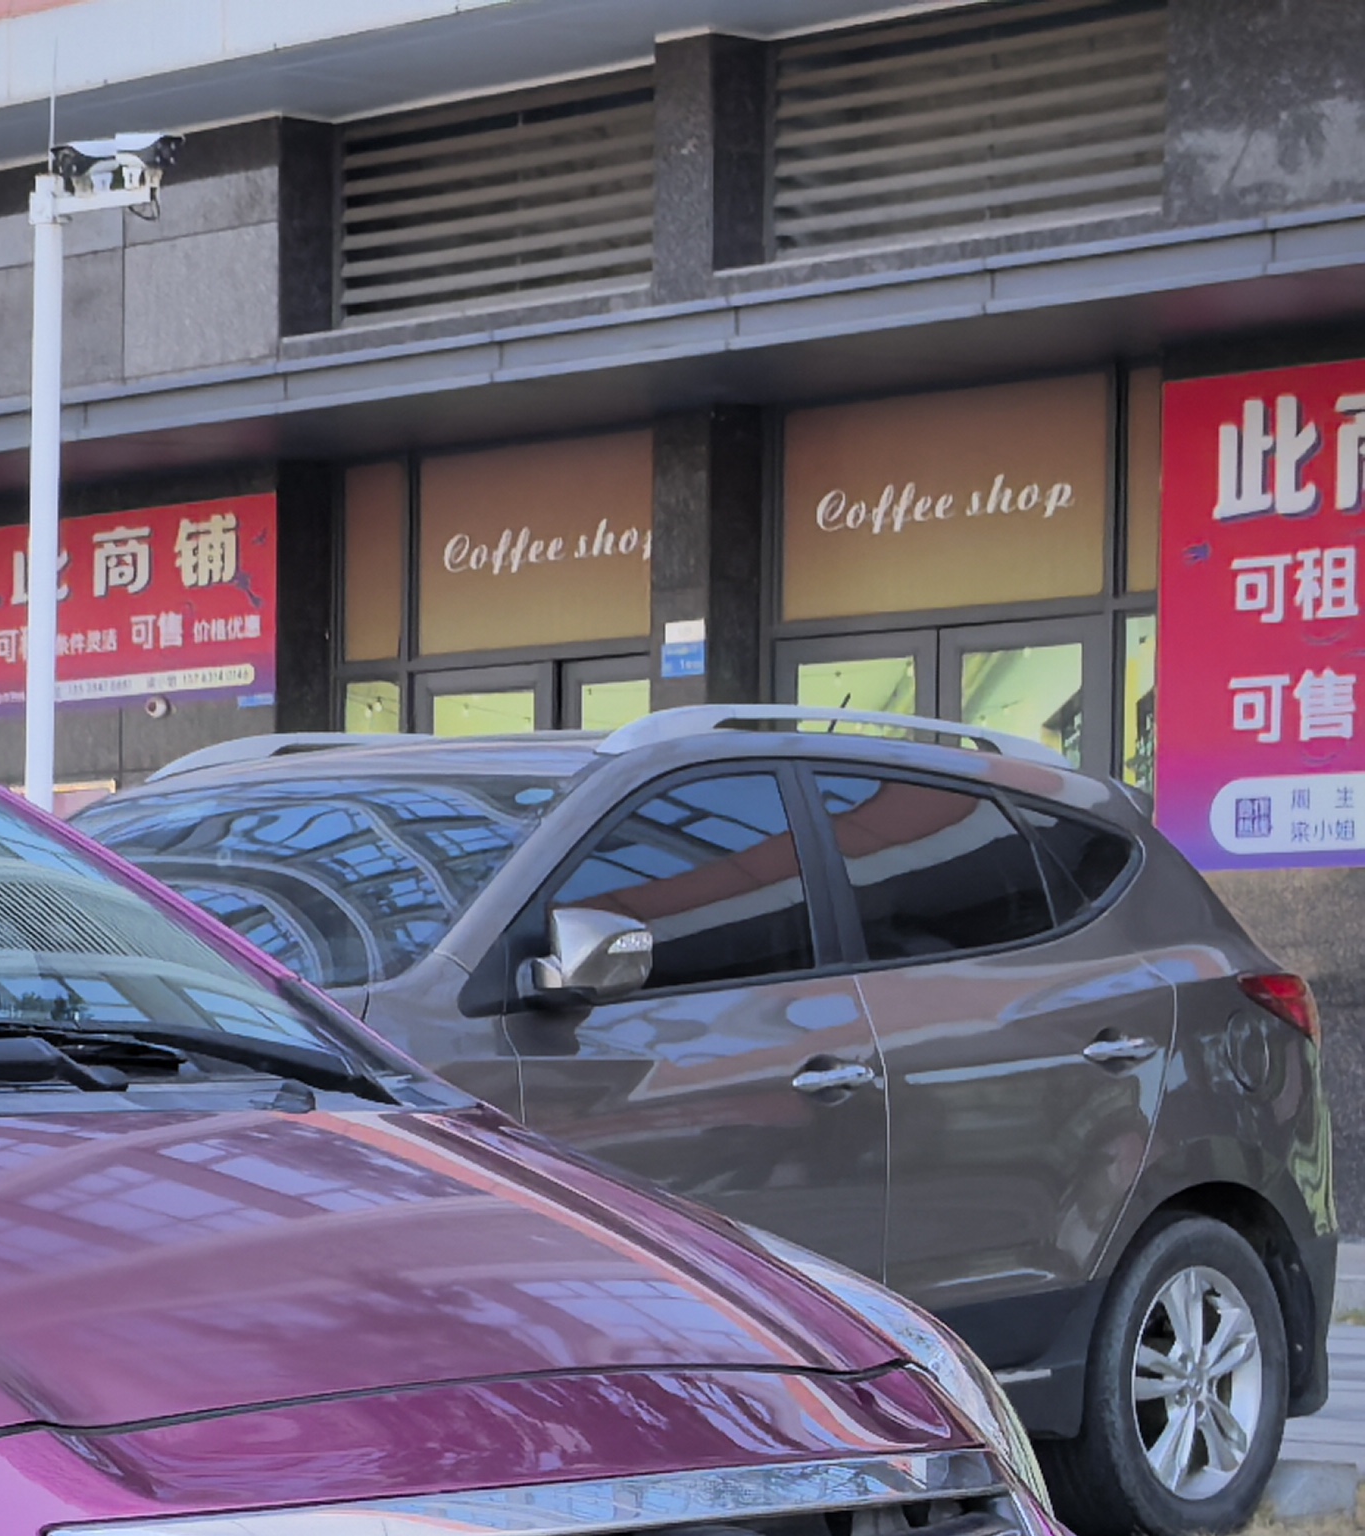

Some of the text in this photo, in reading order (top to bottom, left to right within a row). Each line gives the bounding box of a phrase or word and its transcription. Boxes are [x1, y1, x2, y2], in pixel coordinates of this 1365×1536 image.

[816, 473, 1074, 534] Coffee shop
[444, 526, 563, 575] Coffee
[1230, 546, 1359, 623] 可租
[131, 612, 183, 649] 可售
[1228, 667, 1357, 743] 可售
